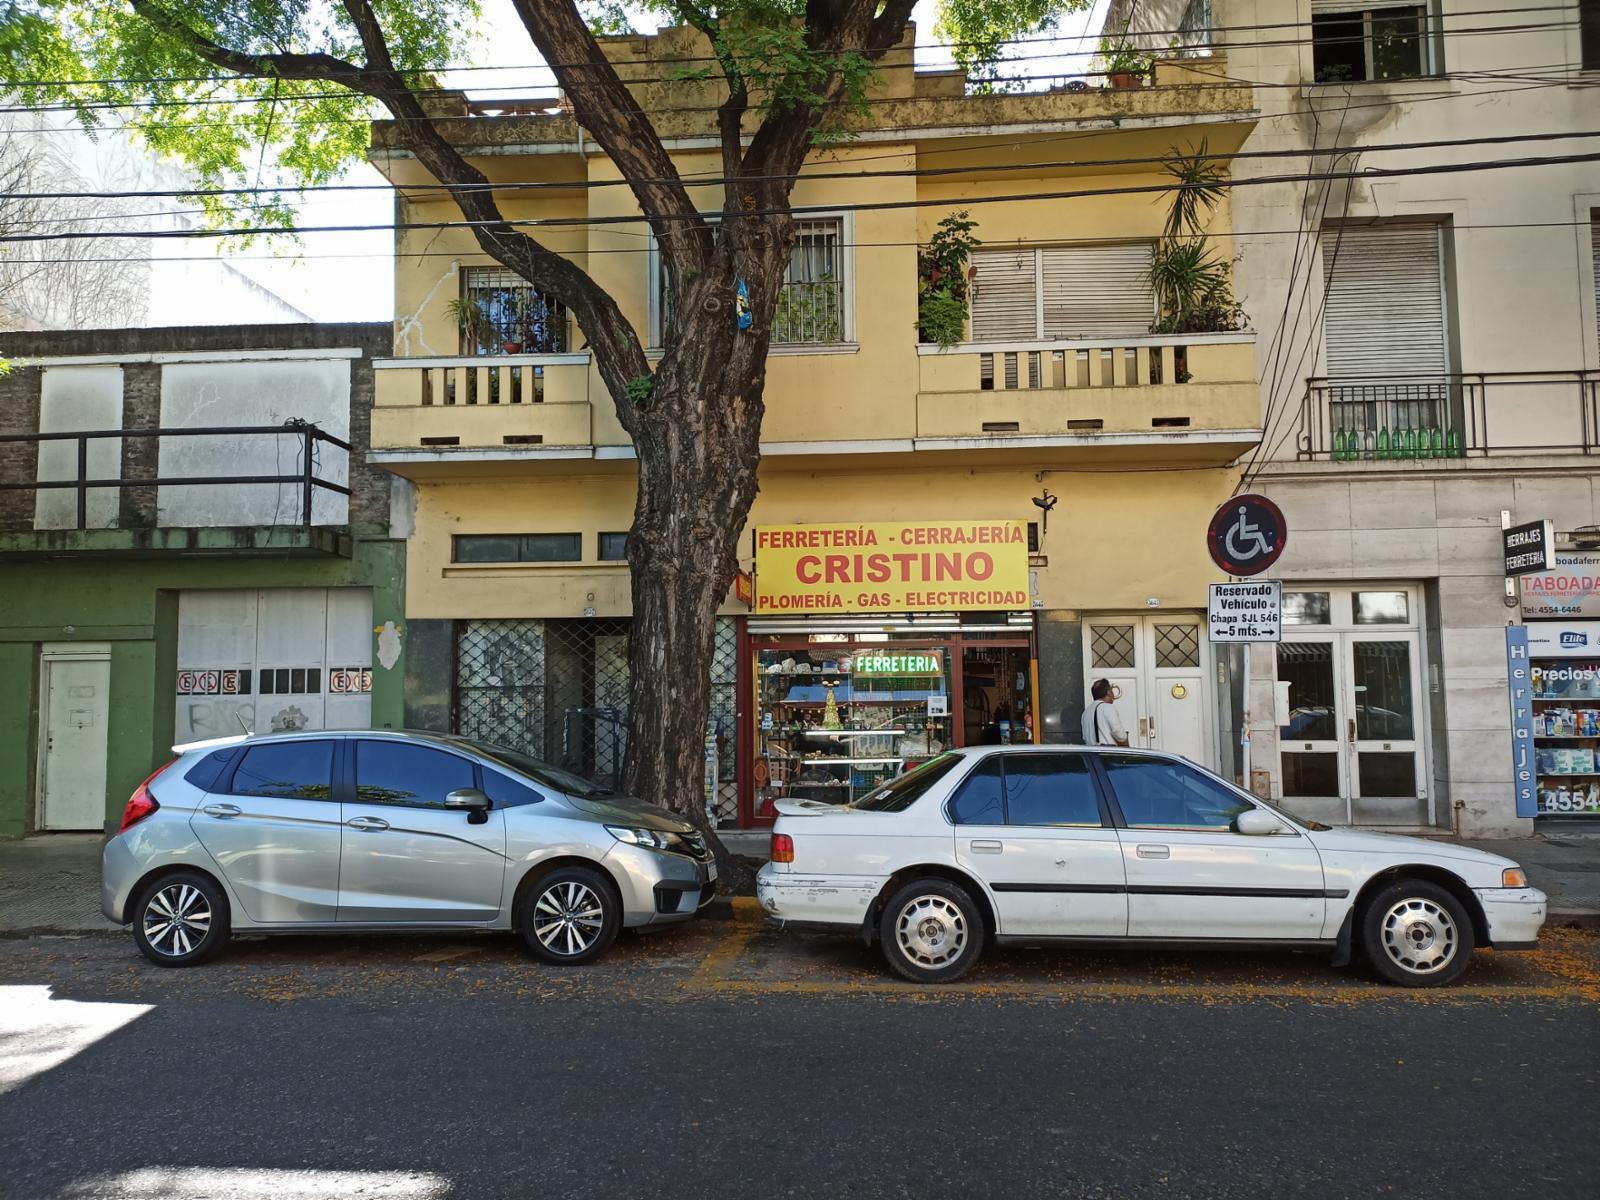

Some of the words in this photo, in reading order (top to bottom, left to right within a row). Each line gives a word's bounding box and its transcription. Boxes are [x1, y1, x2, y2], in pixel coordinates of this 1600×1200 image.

[759, 525, 878, 548] FERRETERÍA
[901, 522, 1024, 544] CERRAJERÍA
[1507, 529, 1541, 547] HERRAJES
[796, 552, 994, 584] CRISTINO
[1556, 557, 1600, 565] boadaferr
[1215, 585, 1272, 596] Reservado
[1521, 576, 1600, 591] TABOADA
[759, 591, 843, 609] PLOMERÍA
[857, 593, 891, 607] GAS
[906, 591, 1026, 606] ELECTRICIDAD
[1538, 606, 1581, 614] 4554-6446
[1211, 613, 1237, 624] Chapa
[1241, 613, 1258, 622] SJL
[1260, 613, 1278, 622] 546
[1229, 625, 1236, 636] 5
[1238, 625, 1261, 636] mts.
[1563, 634, 1585, 643] Elite
[857, 656, 939, 672] FERRETERIA
[1531, 667, 1594, 681] Precios
[1510, 645, 1531, 799] Herrajes
[1546, 785, 1600, 811] 4554
